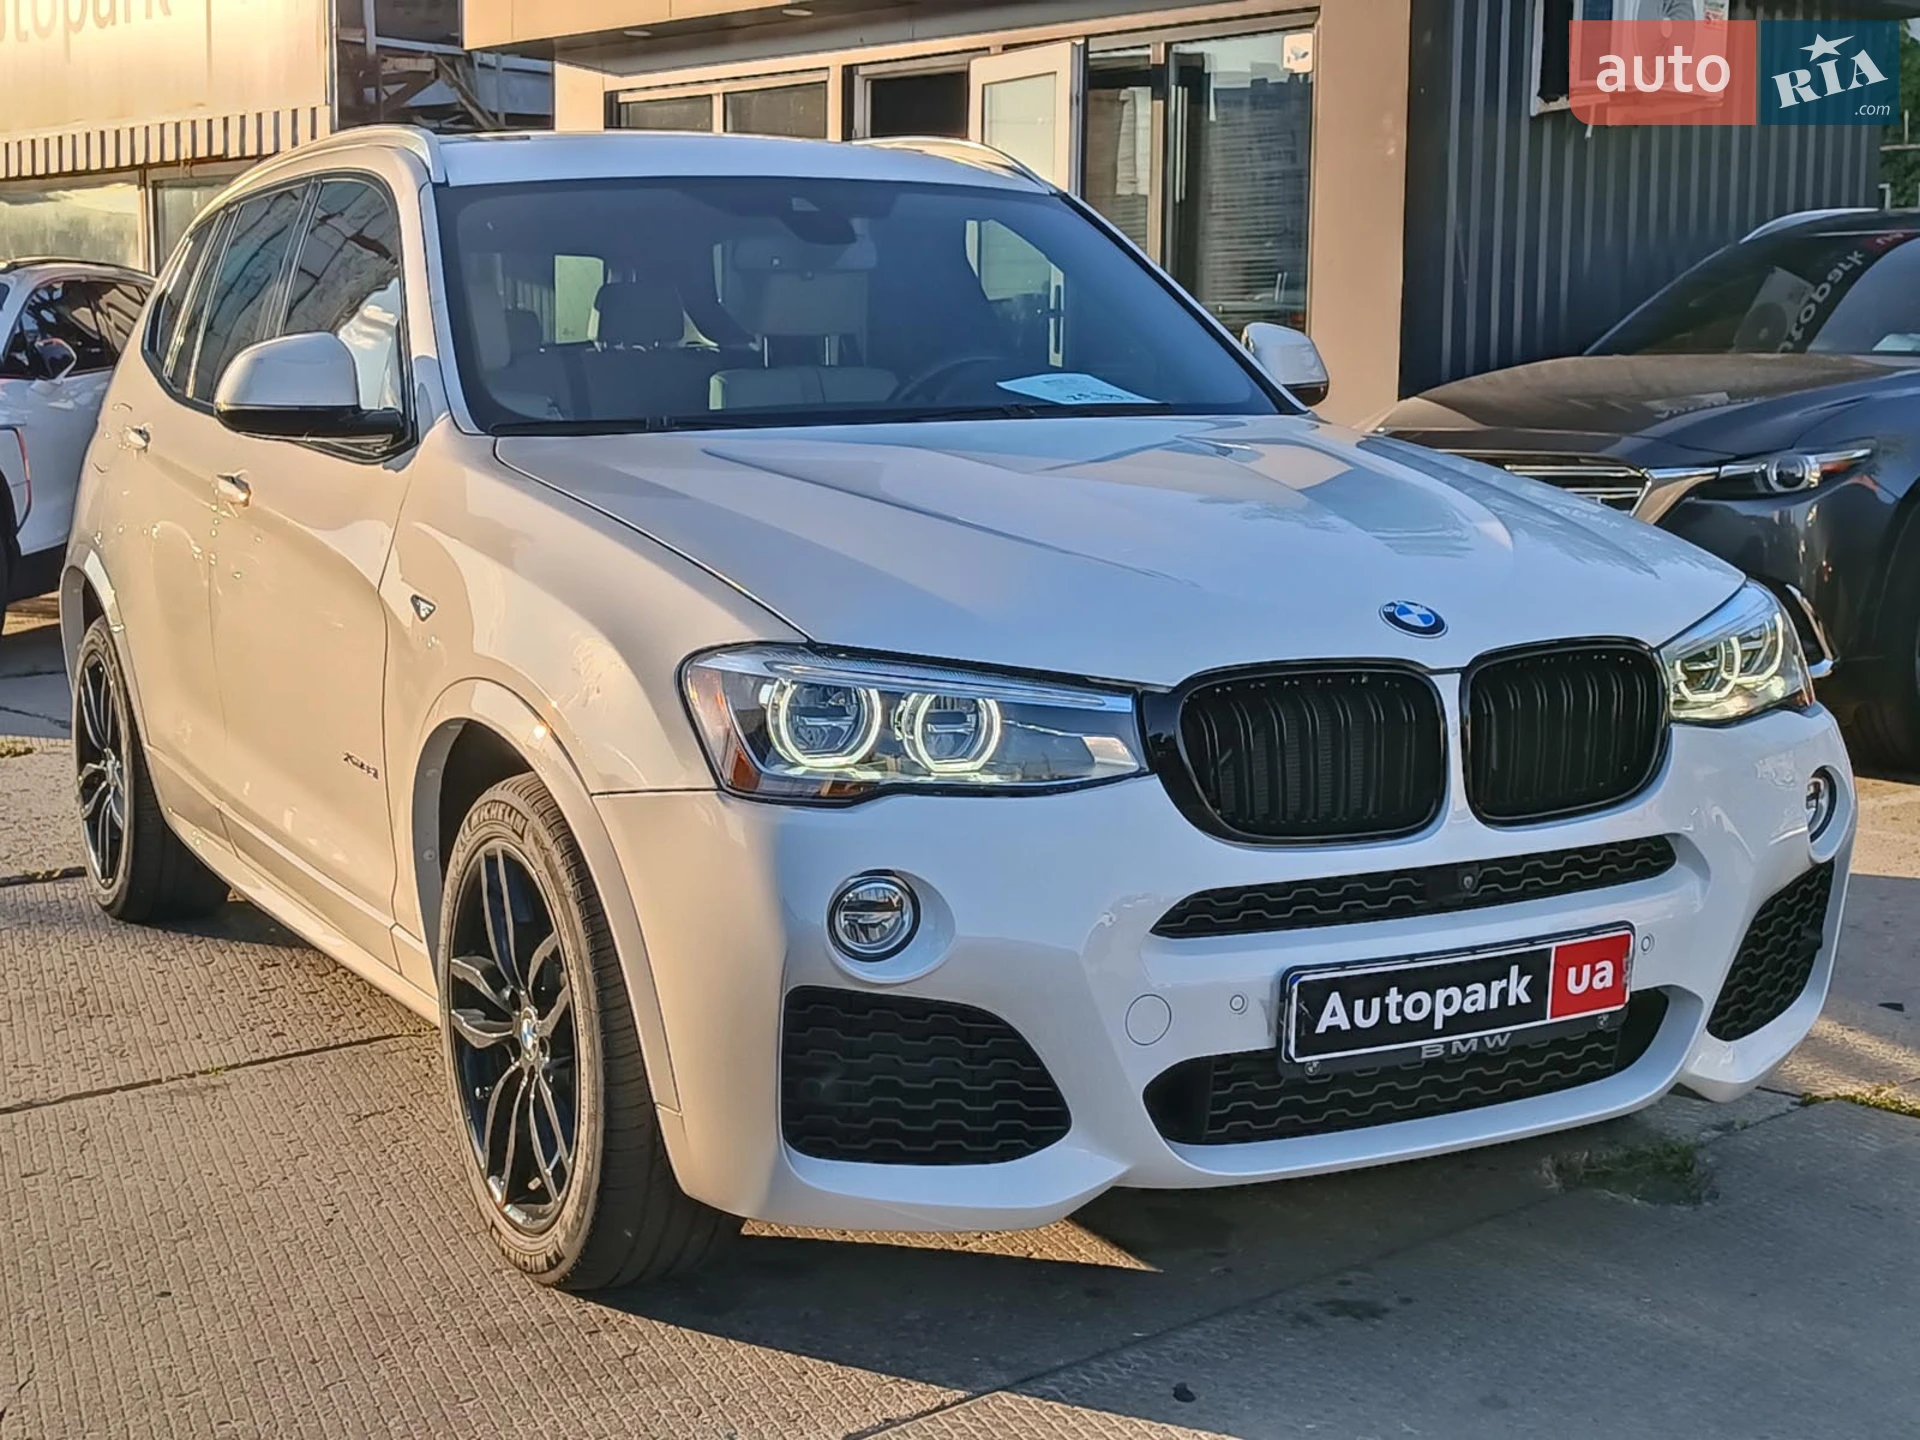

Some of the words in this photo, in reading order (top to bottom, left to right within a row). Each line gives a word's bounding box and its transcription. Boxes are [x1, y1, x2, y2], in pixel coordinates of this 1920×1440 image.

[1314, 965, 1533, 1034] Autopark
[1566, 959, 1614, 996] ua
[1421, 1032, 1512, 1059] BMW
